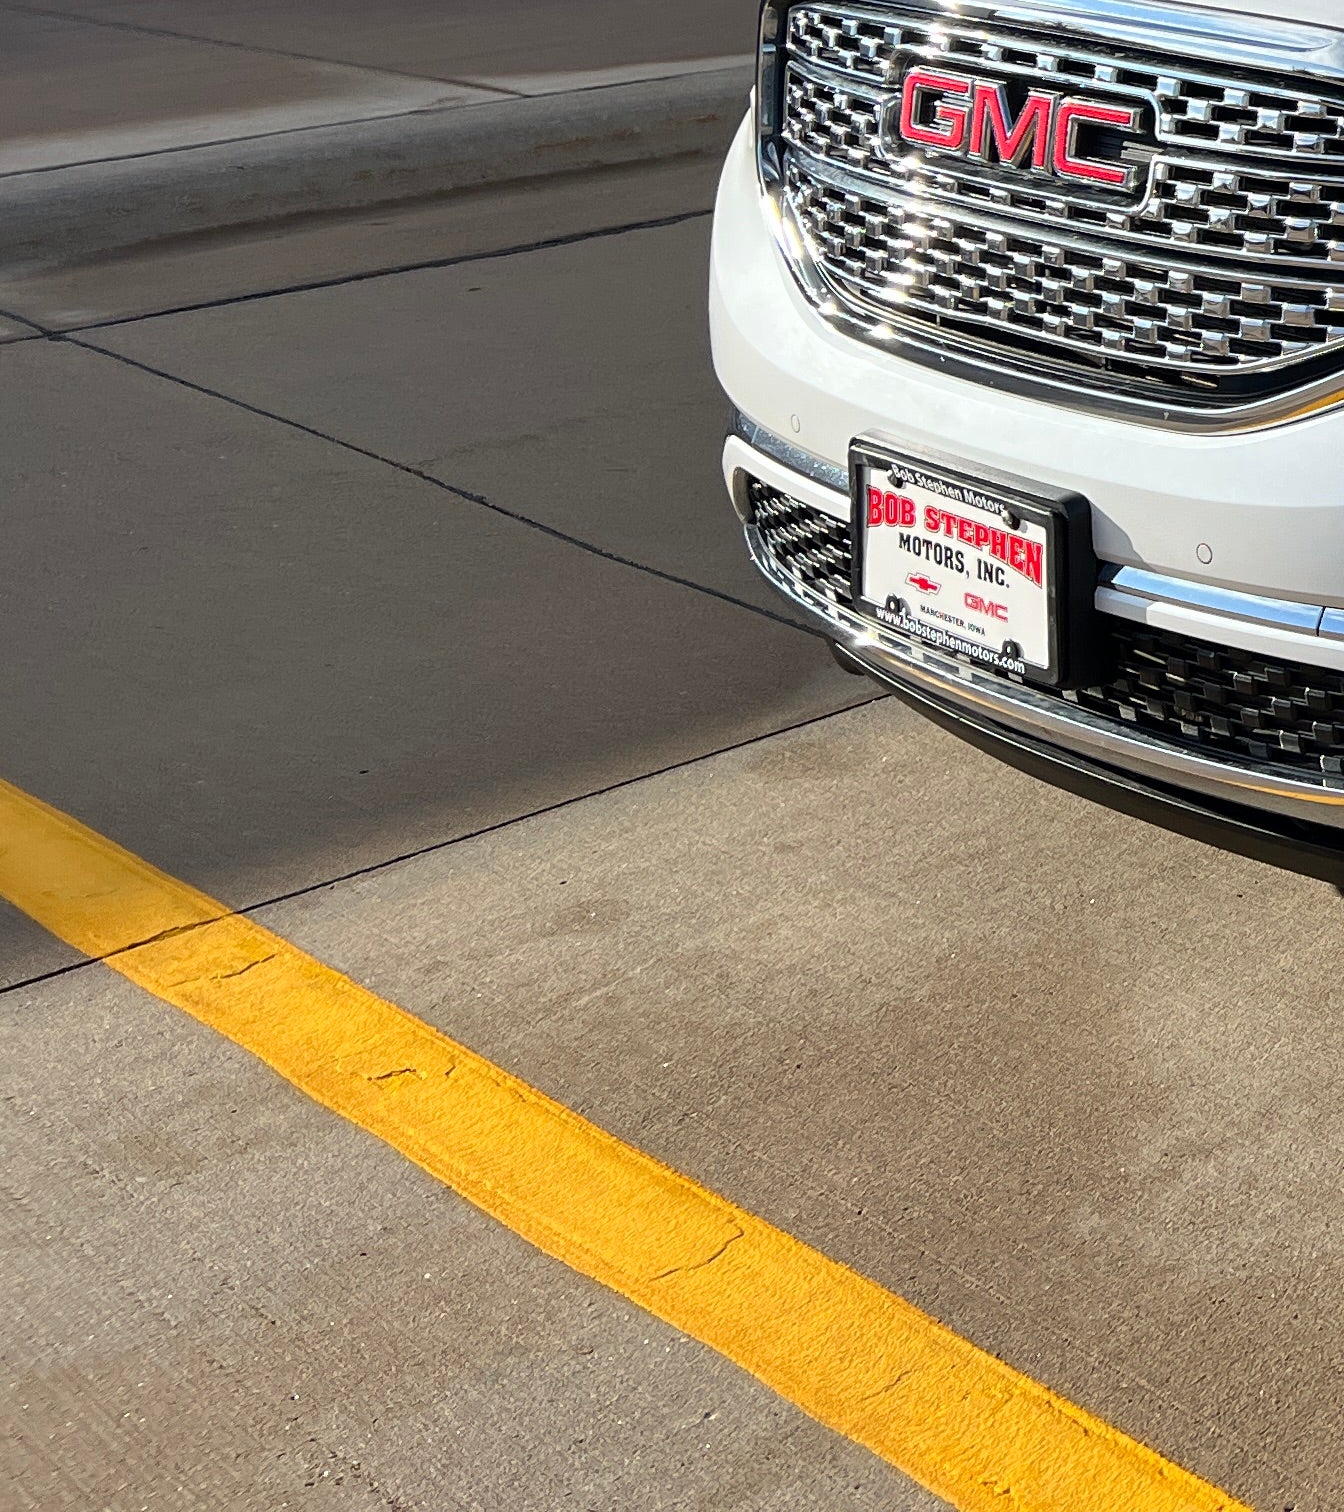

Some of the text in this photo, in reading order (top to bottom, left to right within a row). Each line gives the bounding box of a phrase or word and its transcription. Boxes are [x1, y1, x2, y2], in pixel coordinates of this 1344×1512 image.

[900, 65, 1143, 193] GMC
[891, 463, 1006, 514] Bob Stephen Motors
[866, 484, 1043, 589] BOB STEPHEN
[898, 531, 1011, 589] MOTORS, INC.
[963, 591, 1009, 623] GMC
[875, 606, 1026, 675] www.bobstephenmotors.com
